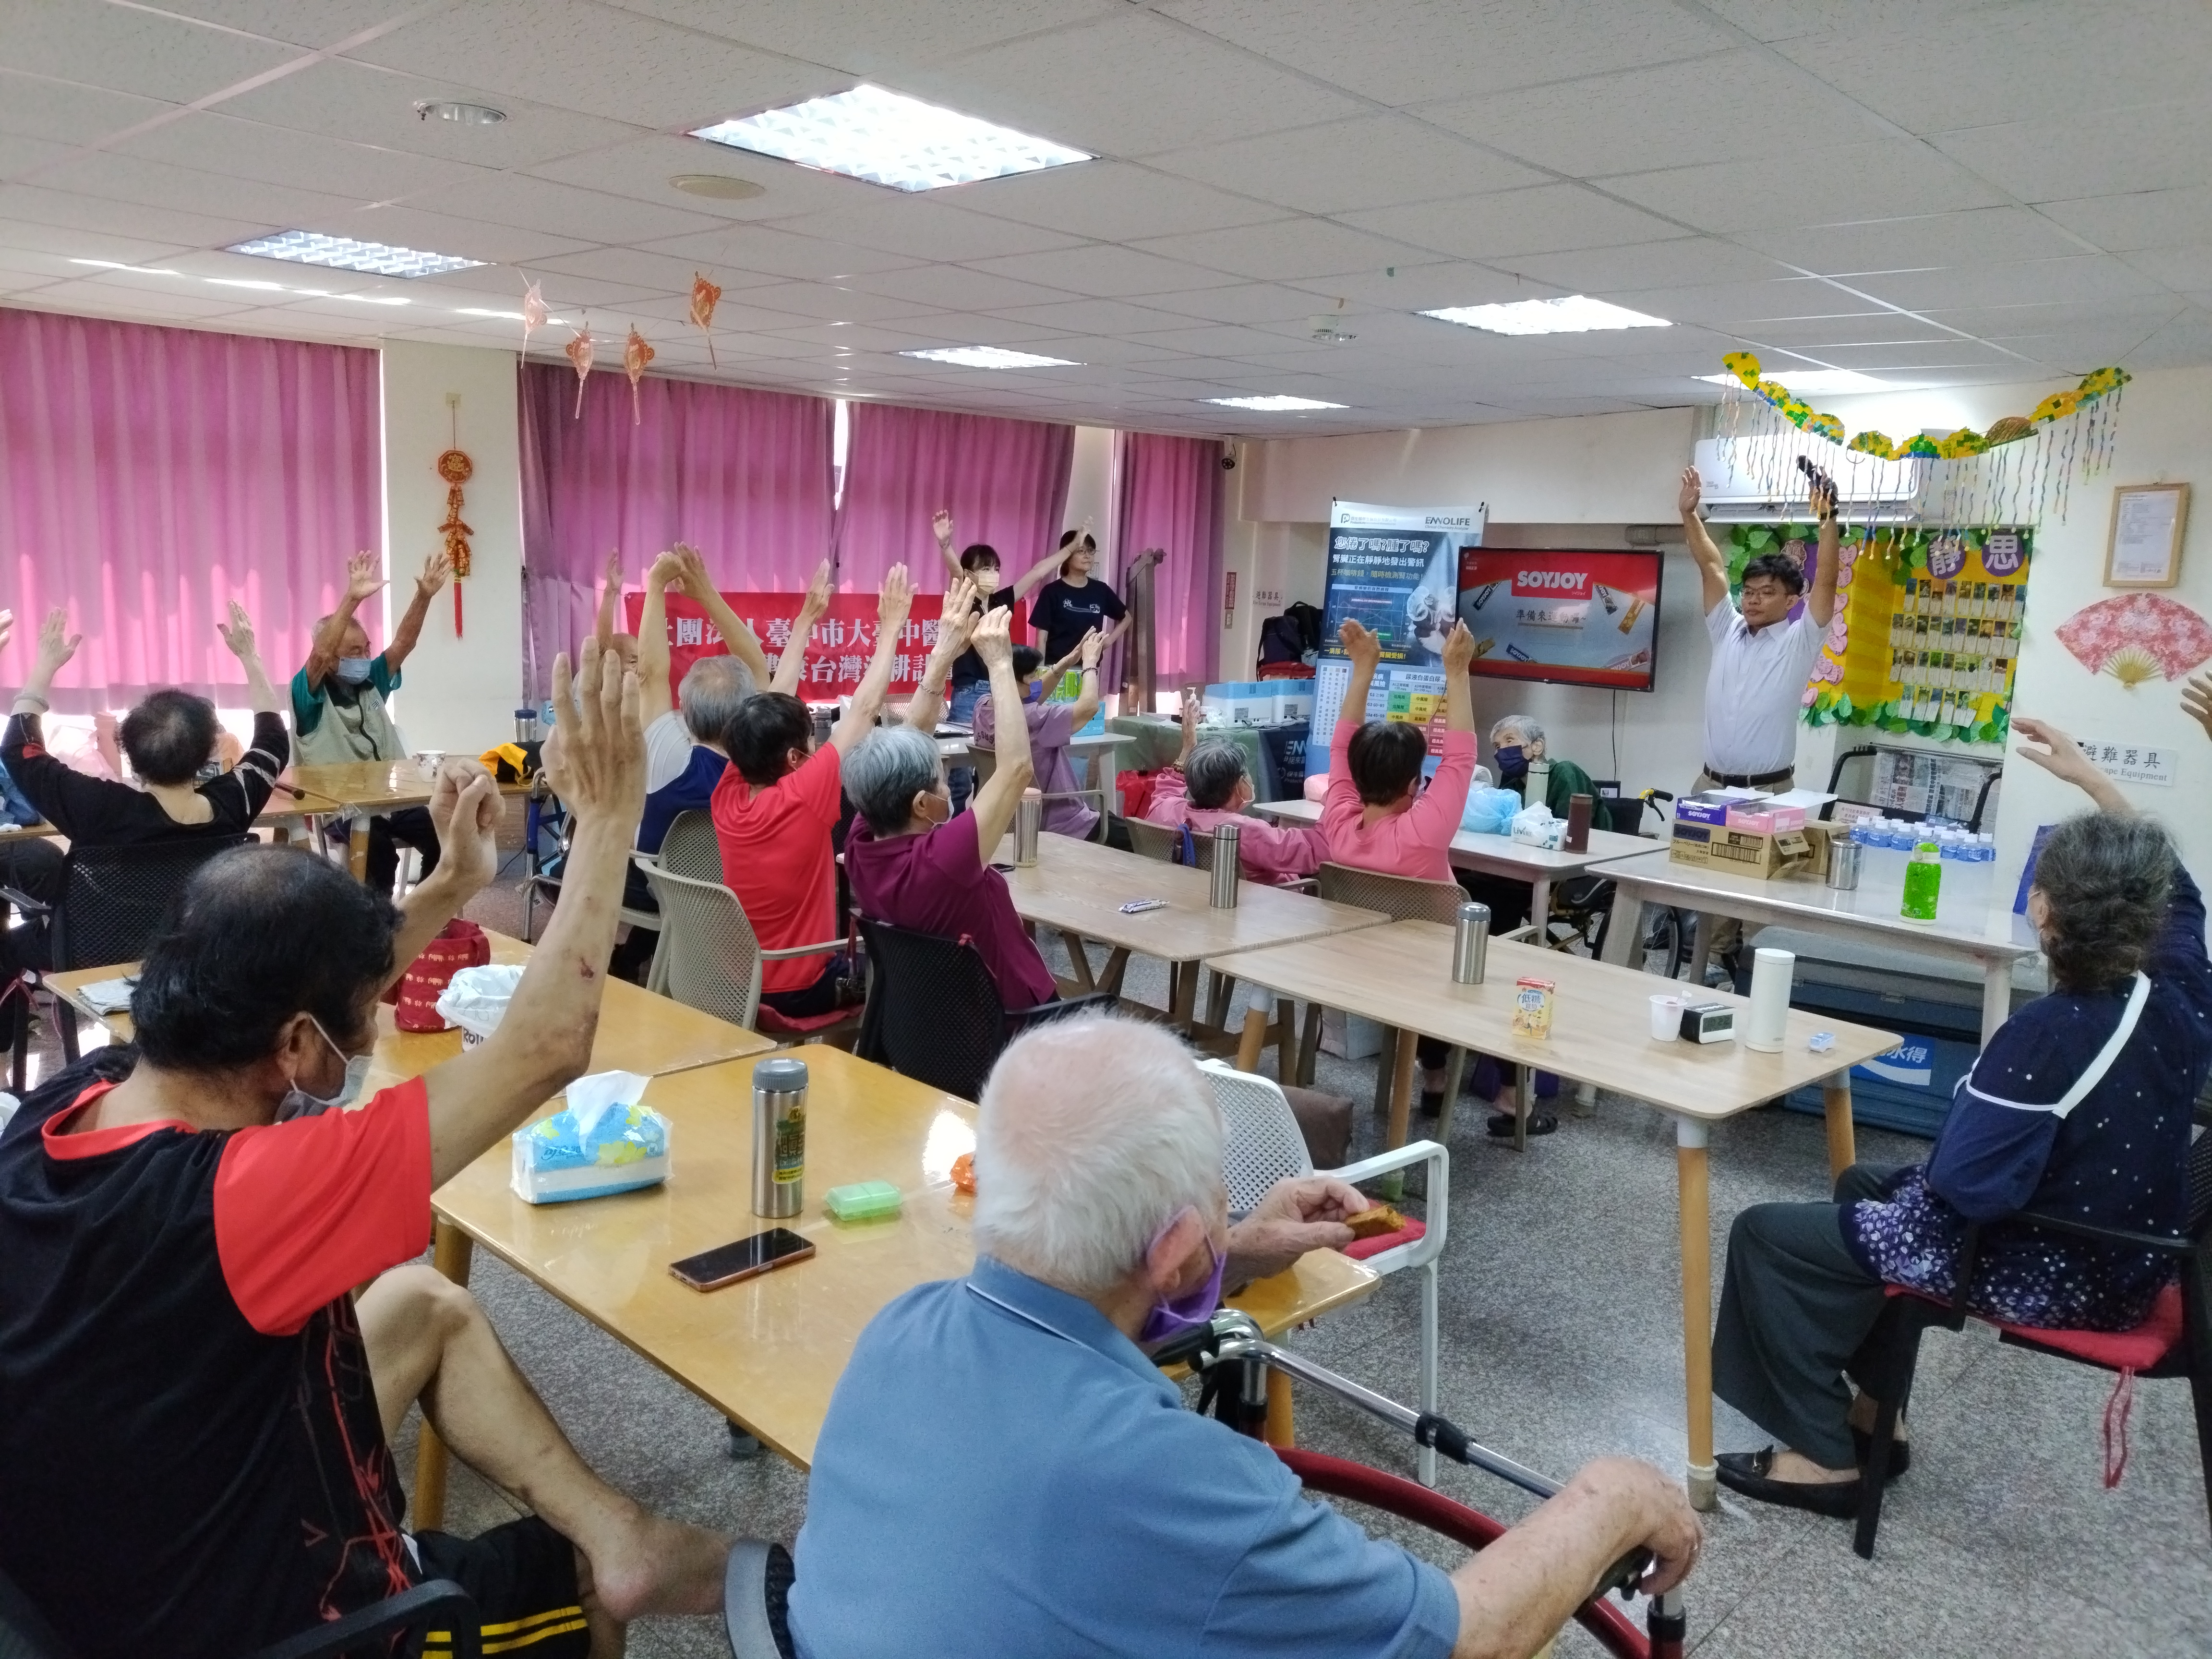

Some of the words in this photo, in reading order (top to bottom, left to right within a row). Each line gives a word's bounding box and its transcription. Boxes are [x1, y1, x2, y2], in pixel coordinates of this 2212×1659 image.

[1333, 554, 1424, 567] 腎臟正在靜靜地發出警訊
[1517, 571, 1588, 589] SOYJOY
[1476, 587, 1492, 607] SOYJOY
[1510, 647, 1529, 662] SOYJOY
[2083, 745, 2160, 769] 避難器具
[2121, 768, 2167, 781] Equipment
[1688, 810, 1711, 819] SOYJOY
[1738, 818, 1760, 827] SOYJOY
[1522, 994, 1541, 1004] 低糖
[1880, 1046, 1928, 1064] 水得
